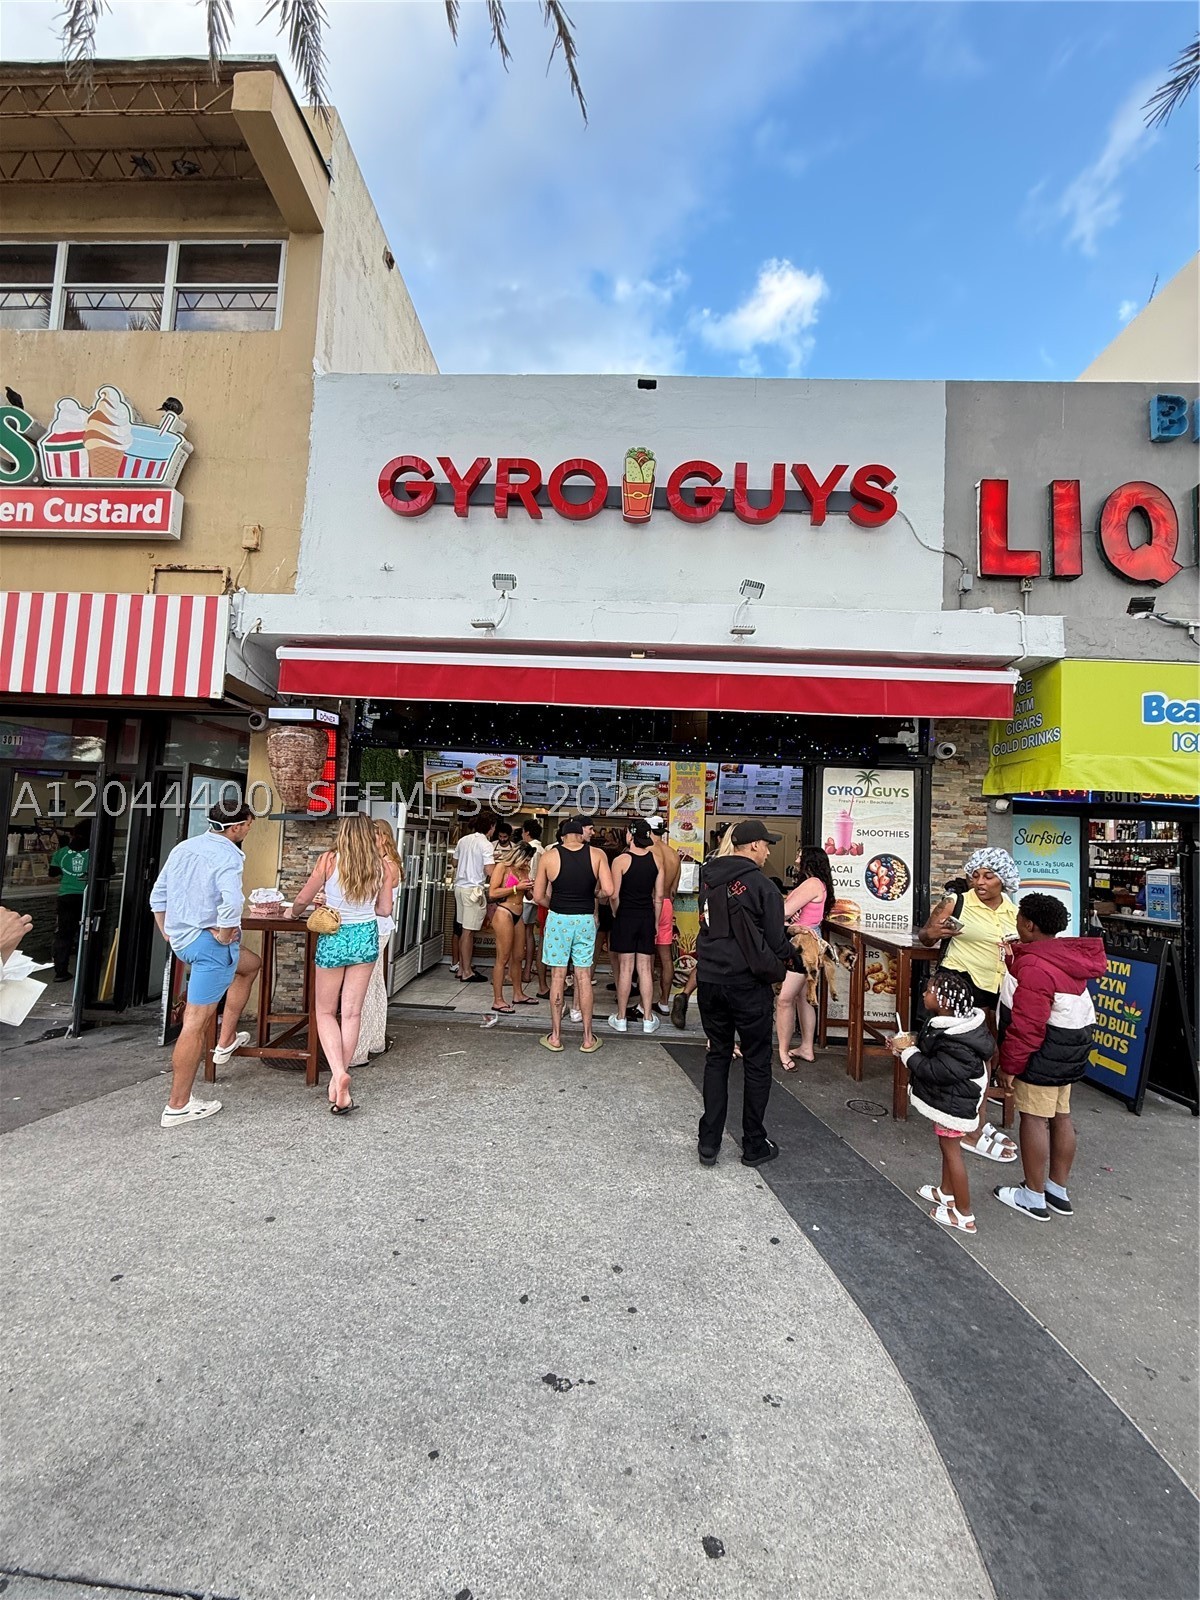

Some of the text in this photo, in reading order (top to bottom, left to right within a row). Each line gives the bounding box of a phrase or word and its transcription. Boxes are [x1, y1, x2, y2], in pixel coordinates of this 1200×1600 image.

[1151, 394, 1200, 442] B
[378, 455, 898, 528] GYRO GUYS
[43, 498, 164, 524] Custard
[977, 479, 1200, 587] LIQ
[1014, 697, 1034, 715] ATM
[1006, 713, 1042, 736] CIGARS
[3, 736, 22, 745] 3011
[993, 727, 1061, 755] COLD DRINKS
[1172, 732, 1200, 752] IC
[828, 786, 909, 798] GYRO GUYS
[1106, 791, 1140, 803] 3015
[857, 829, 909, 838] SMOOTHIES
[1014, 828, 1072, 846] Surfside
[831, 865, 853, 873] ACAI
[1053, 861, 1074, 869] SUGAR
[832, 879, 860, 887] OWLS
[866, 913, 909, 922] BURGERS
[1105, 960, 1131, 977] ATM
[1100, 976, 1126, 995] ZYN
[1097, 994, 1123, 1014] THC
[1095, 1011, 1137, 1040] ED BULL
